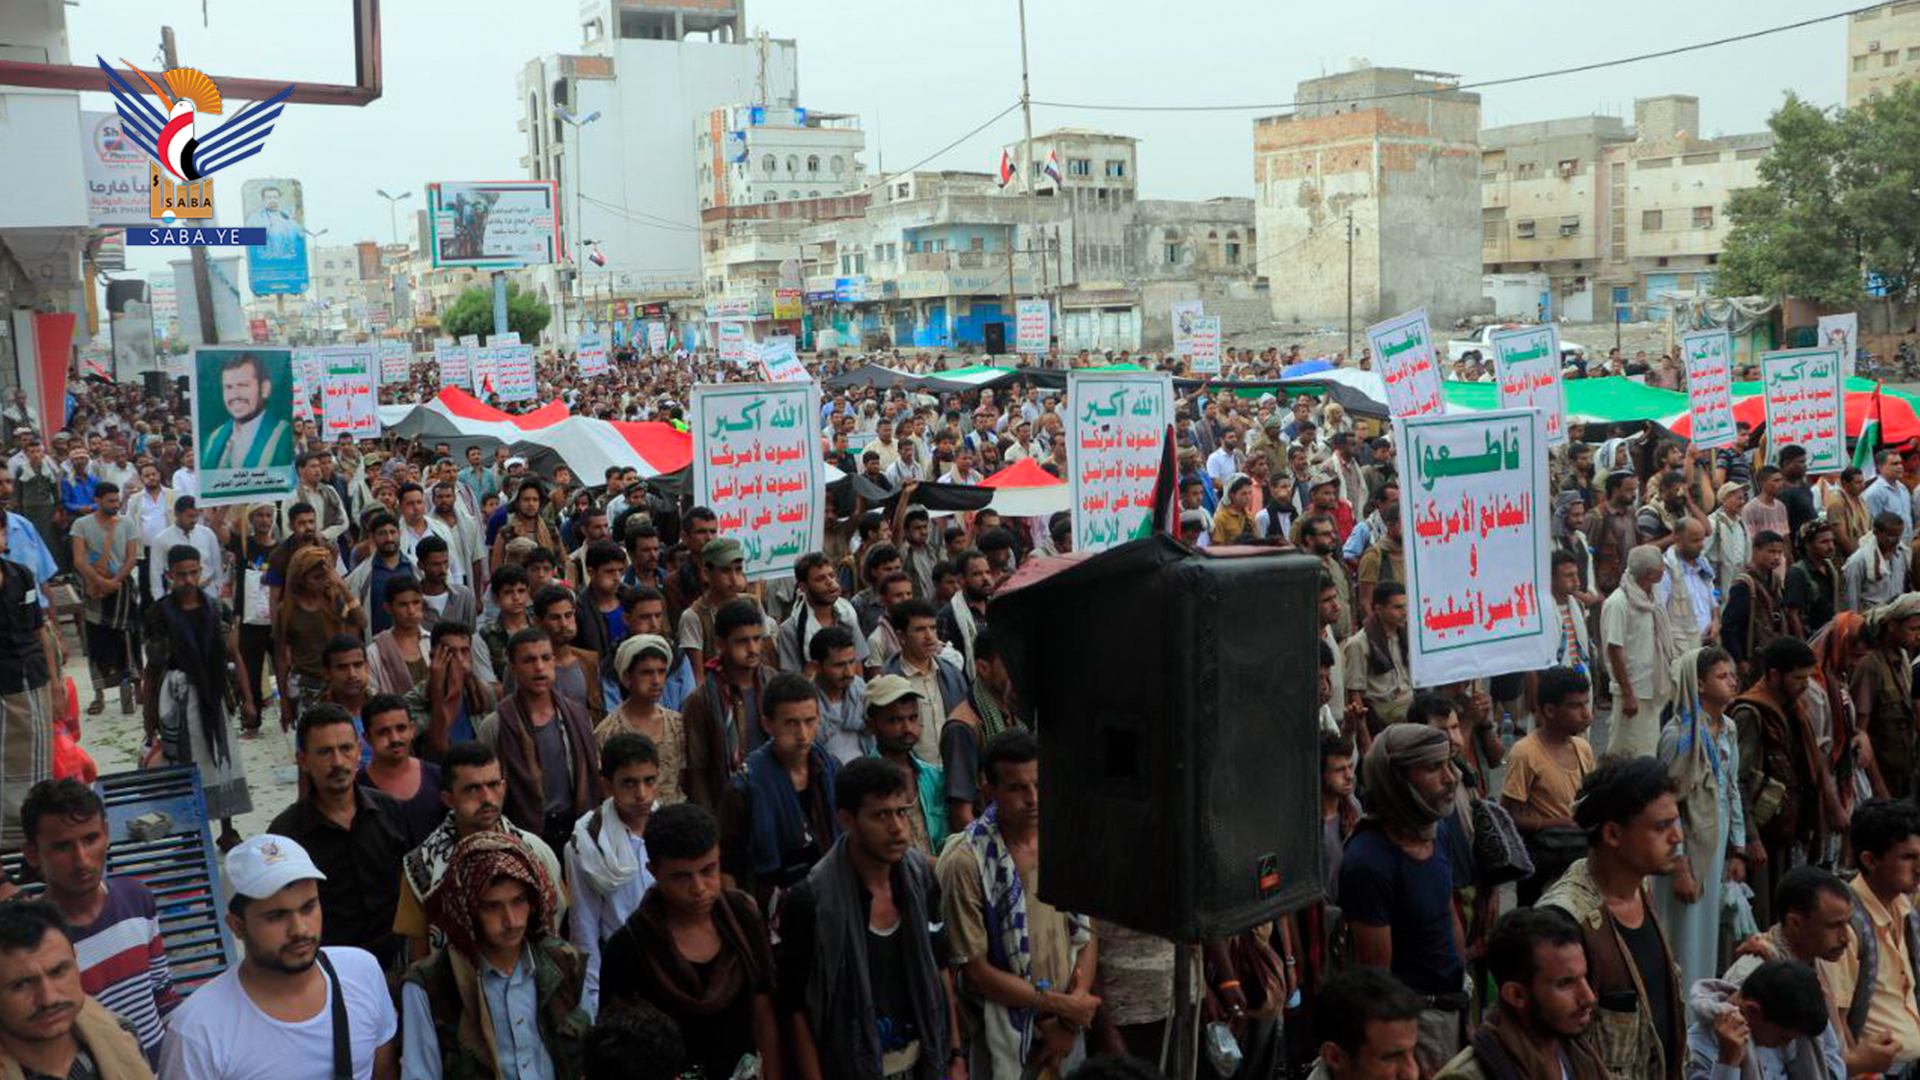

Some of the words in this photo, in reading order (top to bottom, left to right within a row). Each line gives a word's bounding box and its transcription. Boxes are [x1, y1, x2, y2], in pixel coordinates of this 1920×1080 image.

[89, 179, 130, 196] فارما
[1377, 325, 1423, 363] قاطعوا
[1499, 334, 1549, 370] قاطعوا
[1811, 361, 1835, 378] الله
[770, 398, 803, 428] الله
[1081, 385, 1129, 426] أكبر
[1131, 388, 1160, 416] الله
[709, 396, 767, 441] أكبر
[765, 439, 804, 464] الموت
[1080, 424, 1123, 452] لأمريكا
[1126, 427, 1160, 451] الموت
[710, 438, 761, 469] لأمريكا
[1414, 427, 1520, 491] قاطعوا
[766, 472, 808, 497] الموت
[777, 502, 808, 524] اللعنة
[1081, 491, 1109, 515] اليهود
[1111, 491, 1129, 513] على
[1479, 491, 1532, 540] البضائع
[719, 507, 747, 535] اليهو
[751, 506, 771, 530] على
[1414, 489, 1475, 545] الأمريكية
[765, 529, 807, 565] النصر
[1469, 542, 1478, 578] و
[1423, 580, 1537, 639] الإسرائيلية
